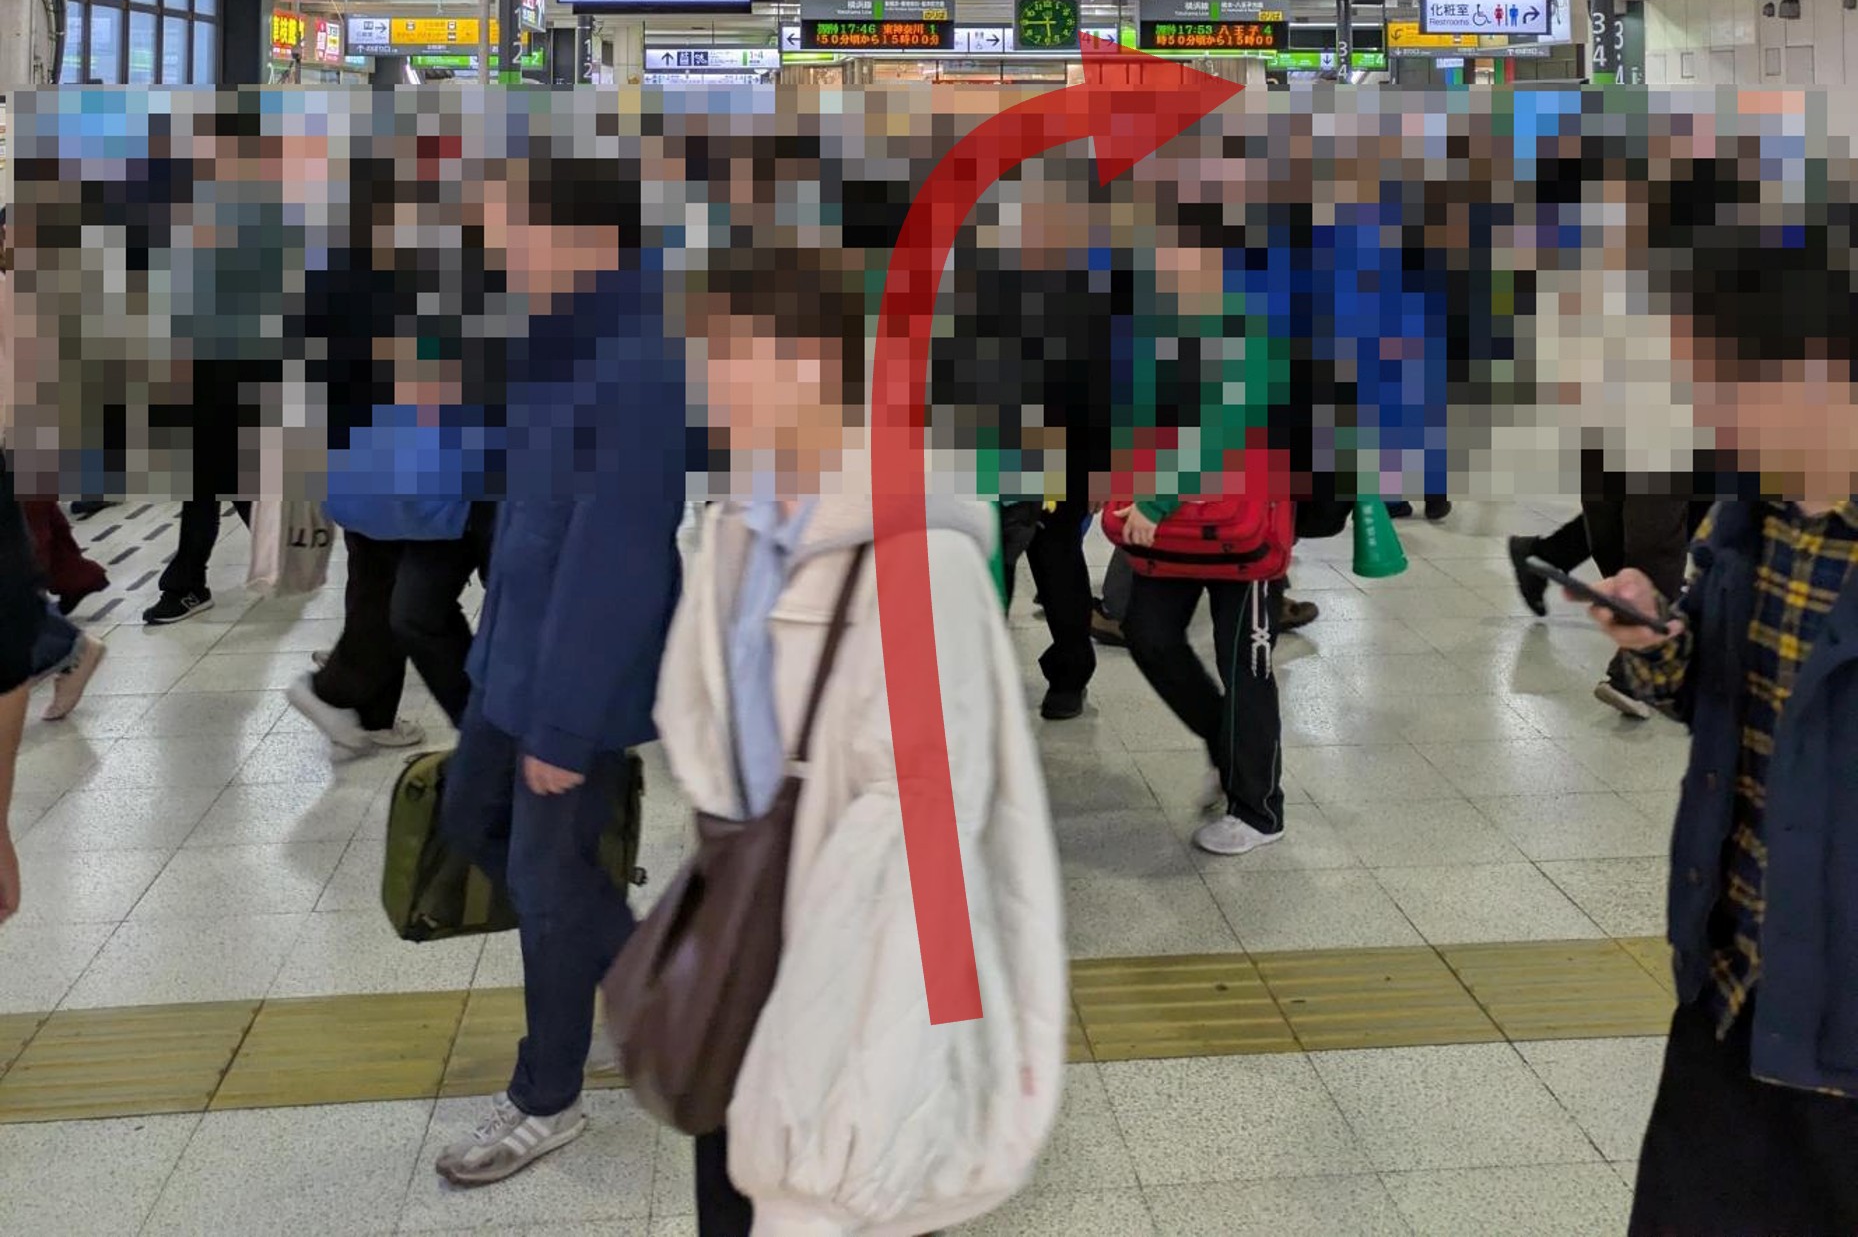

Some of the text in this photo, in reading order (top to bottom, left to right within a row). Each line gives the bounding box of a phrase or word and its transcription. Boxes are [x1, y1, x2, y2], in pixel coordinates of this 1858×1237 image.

[1430, 3, 1470, 17] 化粧室
[1429, 17, 1470, 26] Restrooms
[840, 23, 876, 34] 17:46
[1178, 24, 1213, 35] 17:53
